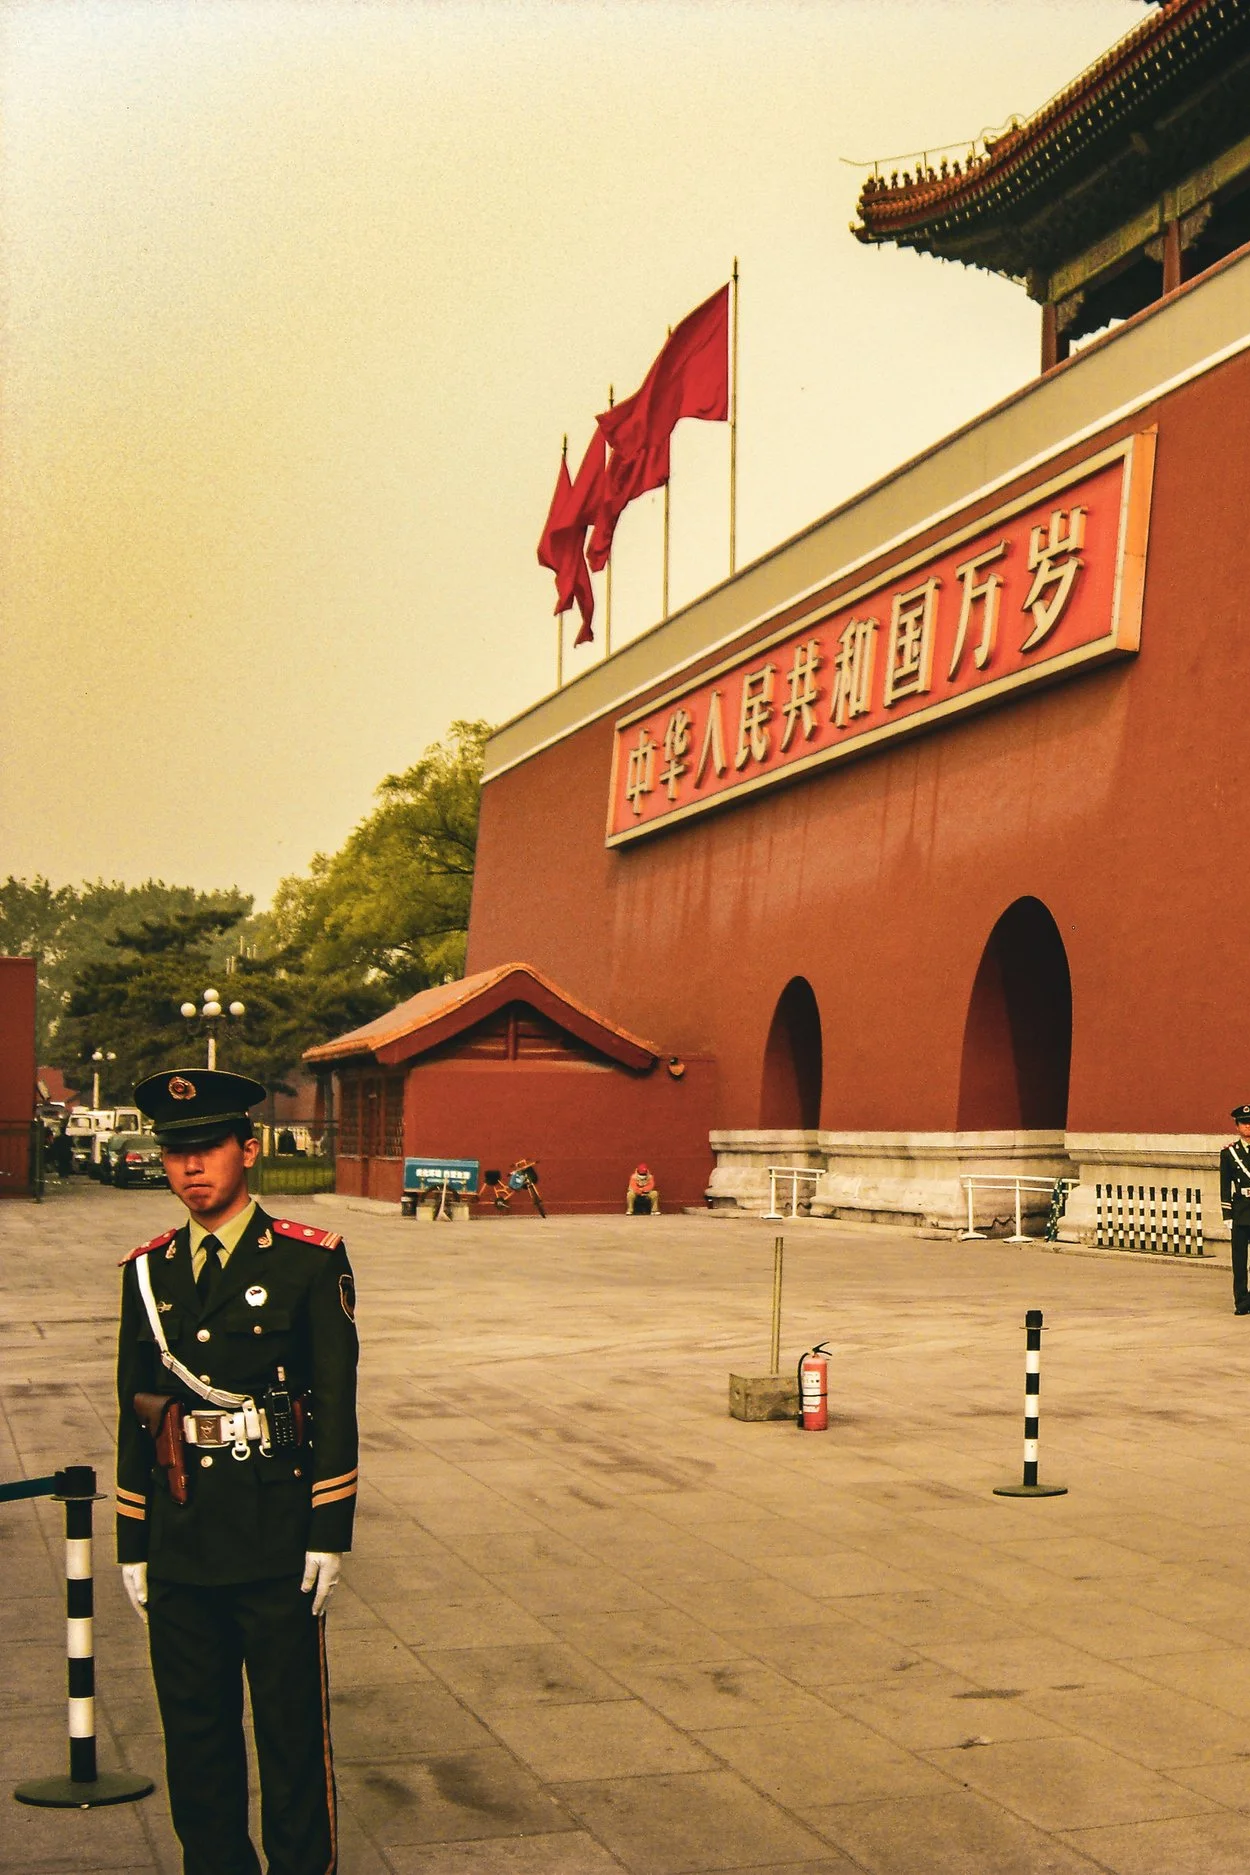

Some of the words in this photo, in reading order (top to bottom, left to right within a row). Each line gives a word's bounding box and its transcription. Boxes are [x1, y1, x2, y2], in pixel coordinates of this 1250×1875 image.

[625, 505, 1088, 815] 中华人民共和国万岁
